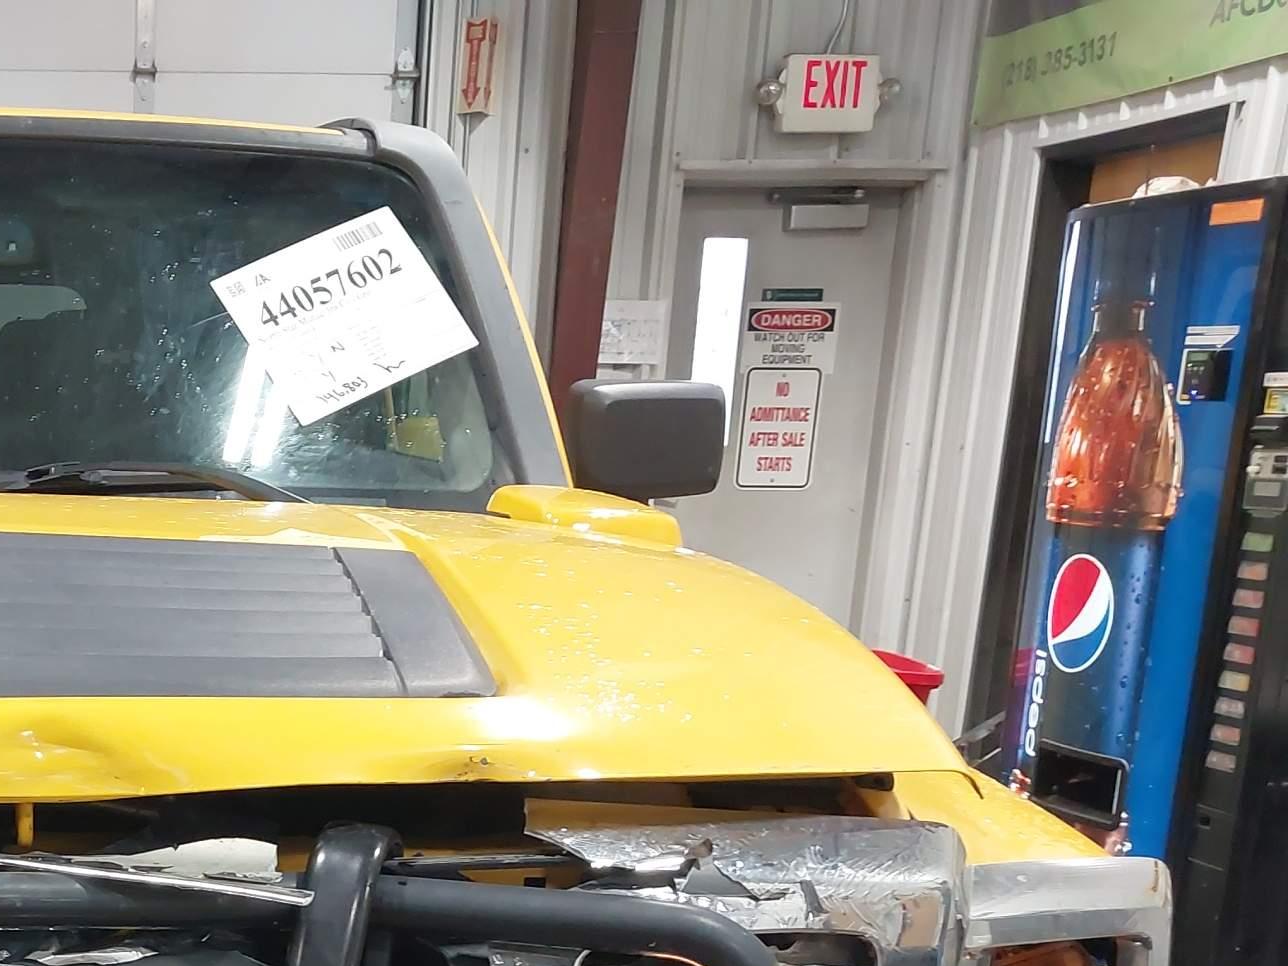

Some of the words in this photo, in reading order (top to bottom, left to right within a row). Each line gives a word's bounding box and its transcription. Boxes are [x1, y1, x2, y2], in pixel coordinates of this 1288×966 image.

[1209, 0, 1288, 28] AFCD
[803, 60, 868, 108] EXIT
[261, 248, 402, 327] 44057602
[760, 314, 822, 327] DANGER
[754, 333, 784, 342] WATCH
[787, 333, 805, 342] OUT
[807, 333, 825, 342] FOR
[772, 344, 805, 353] MOVING
[762, 355, 812, 364] EQUIPMENT
[776, 382, 790, 397] NO
[750, 407, 810, 422] ADMITTANCE
[749, 432, 779, 447] AFTER
[781, 432, 806, 447] SALE
[756, 457, 792, 472] STARTS
[1025, 649, 1048, 757] pepsi
